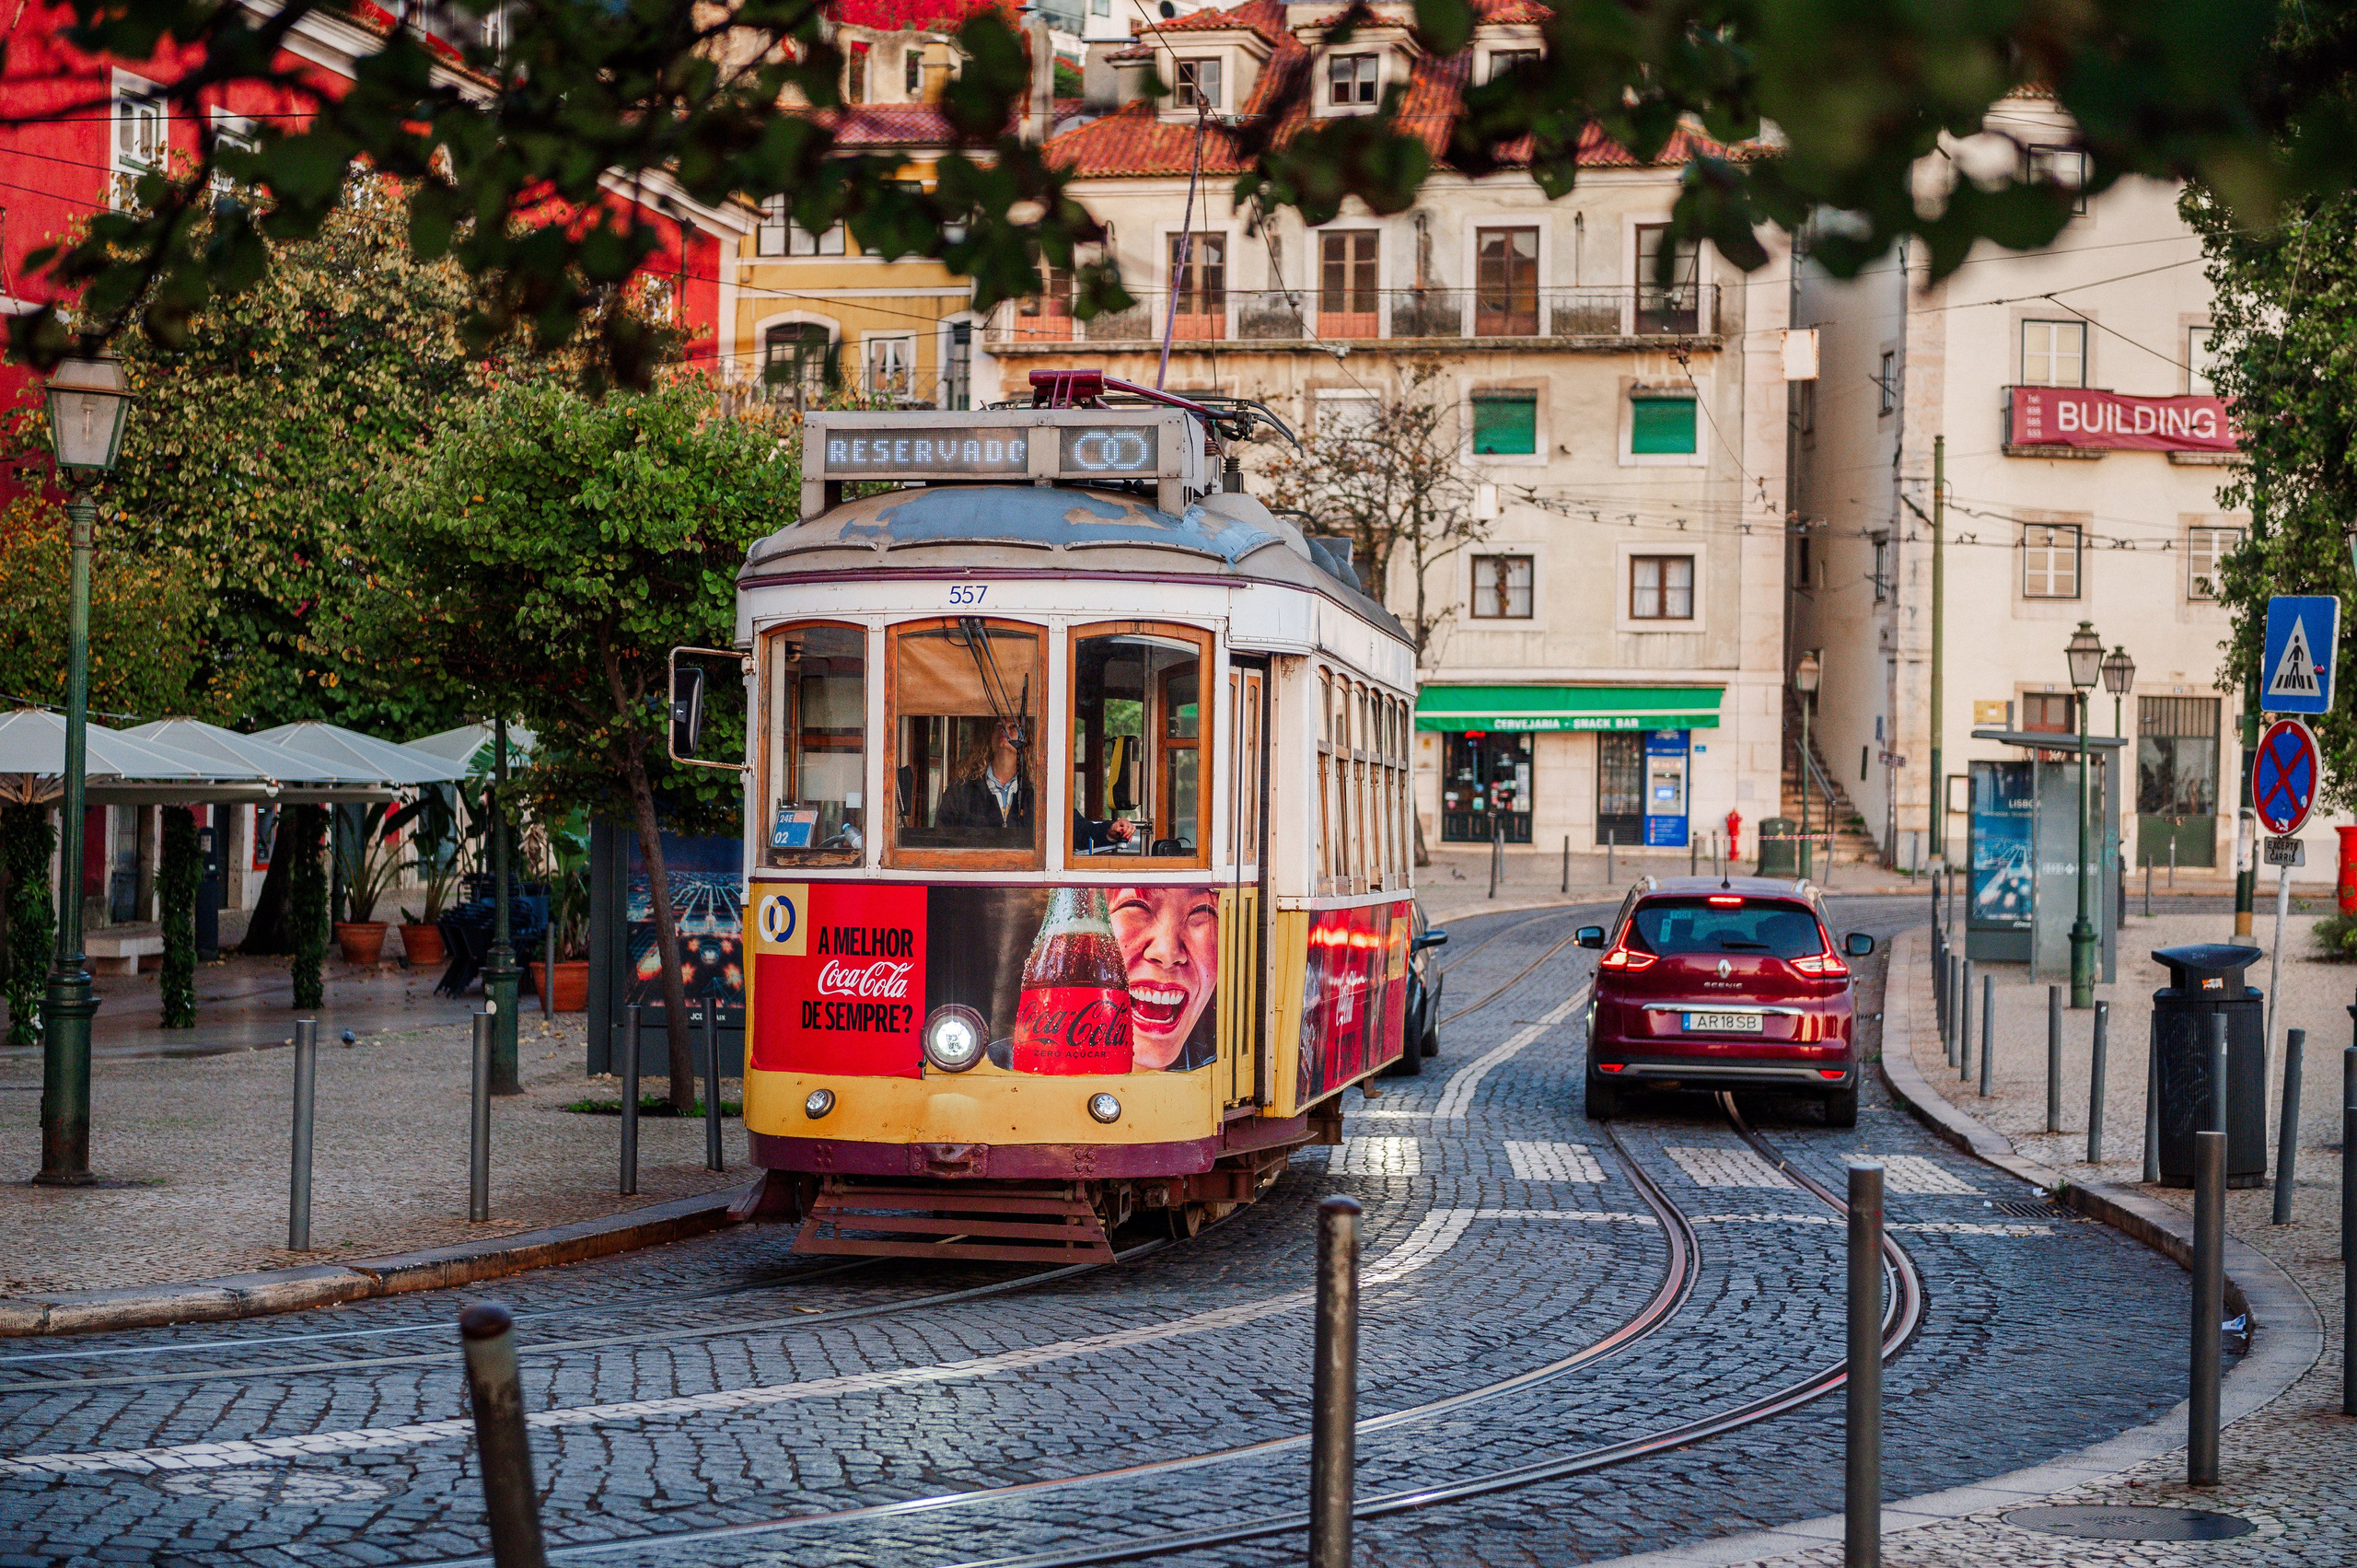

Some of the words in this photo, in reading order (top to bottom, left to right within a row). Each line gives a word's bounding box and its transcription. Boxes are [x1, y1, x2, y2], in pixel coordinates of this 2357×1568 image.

[2058, 401, 2217, 439] BUILDING
[948, 585, 989, 605] 557
[1493, 718, 1561, 729] CERVEJARIA
[1573, 718, 1611, 729] SNACK
[1615, 717, 1640, 728] BAR
[779, 814, 794, 823] 24E
[774, 831, 789, 844] 02
[2270, 853, 2296, 863] CARRIS
[818, 926, 830, 955] A
[833, 926, 914, 958] MELHOR
[818, 959, 915, 998] Coca-Cola
[801, 1000, 823, 1030] DE
[824, 1002, 914, 1034] SEMPRE?
[1016, 1000, 1129, 1047] Coca-Cola
[1065, 1049, 1107, 1059] AÇÚCAR
